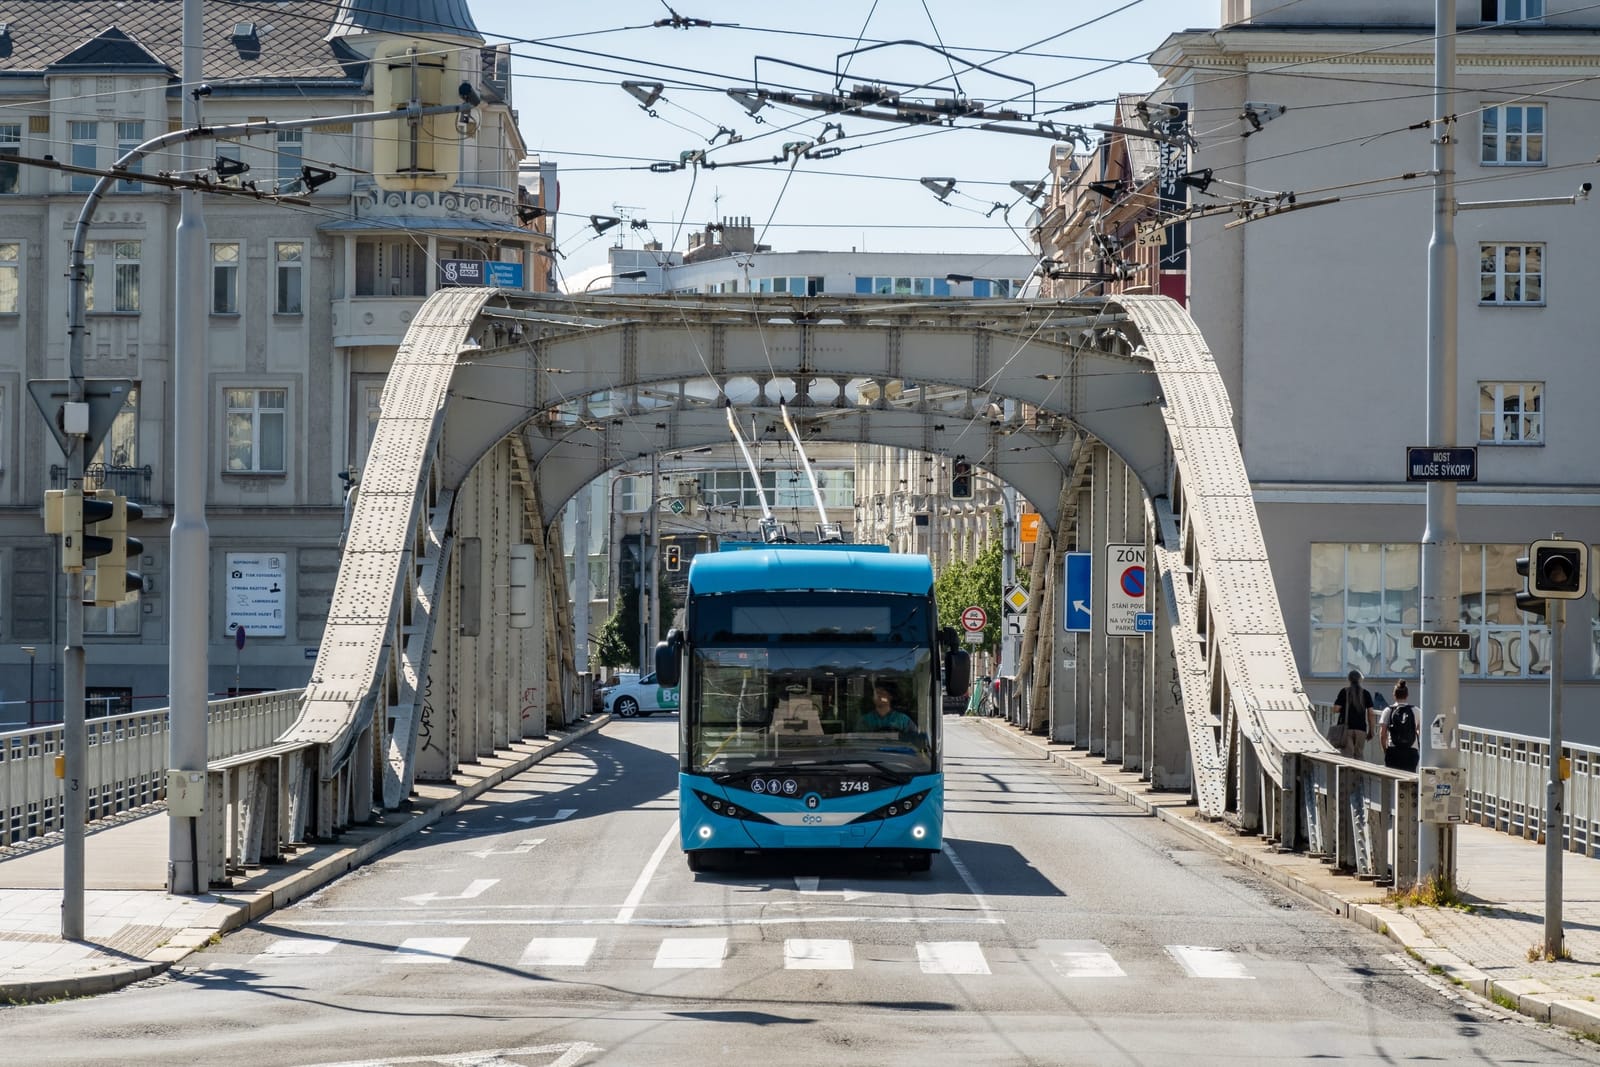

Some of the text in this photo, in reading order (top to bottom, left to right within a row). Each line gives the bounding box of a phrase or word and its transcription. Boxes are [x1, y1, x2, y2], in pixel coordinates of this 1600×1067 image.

[1433, 452, 1450, 462] MOST
[1413, 462, 1471, 476] MILOŠE SÝKORY
[1116, 547, 1145, 562] ZÓN
[1422, 635, 1460, 647] OV-114
[71, 778, 79, 791] 3
[840, 781, 869, 792] 3748
